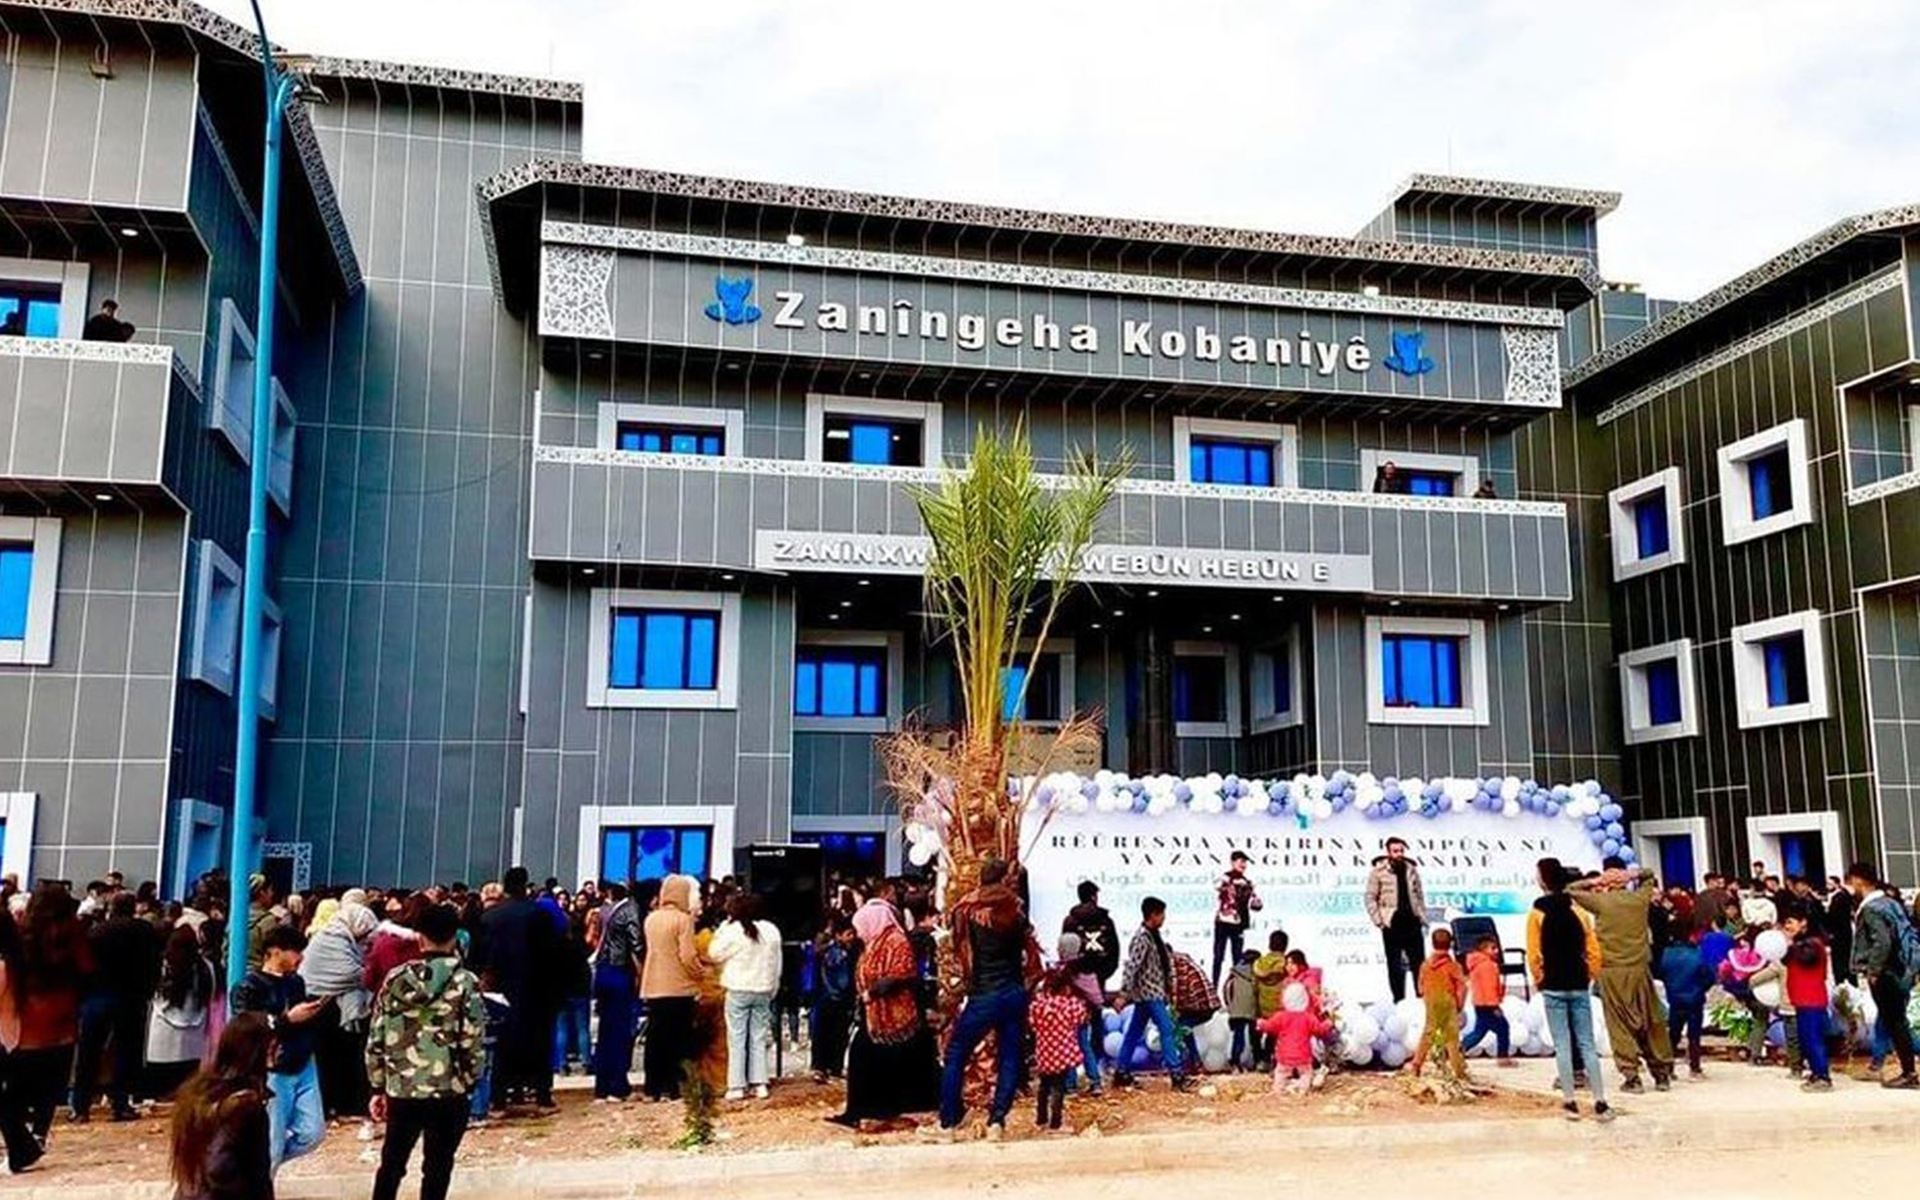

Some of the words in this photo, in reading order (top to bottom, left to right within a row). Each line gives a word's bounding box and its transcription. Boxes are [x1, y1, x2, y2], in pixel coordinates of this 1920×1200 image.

[773, 291, 1099, 352] Zanîngeha
[1123, 320, 1371, 376] Kobaniyê
[1313, 562, 1329, 582] E
